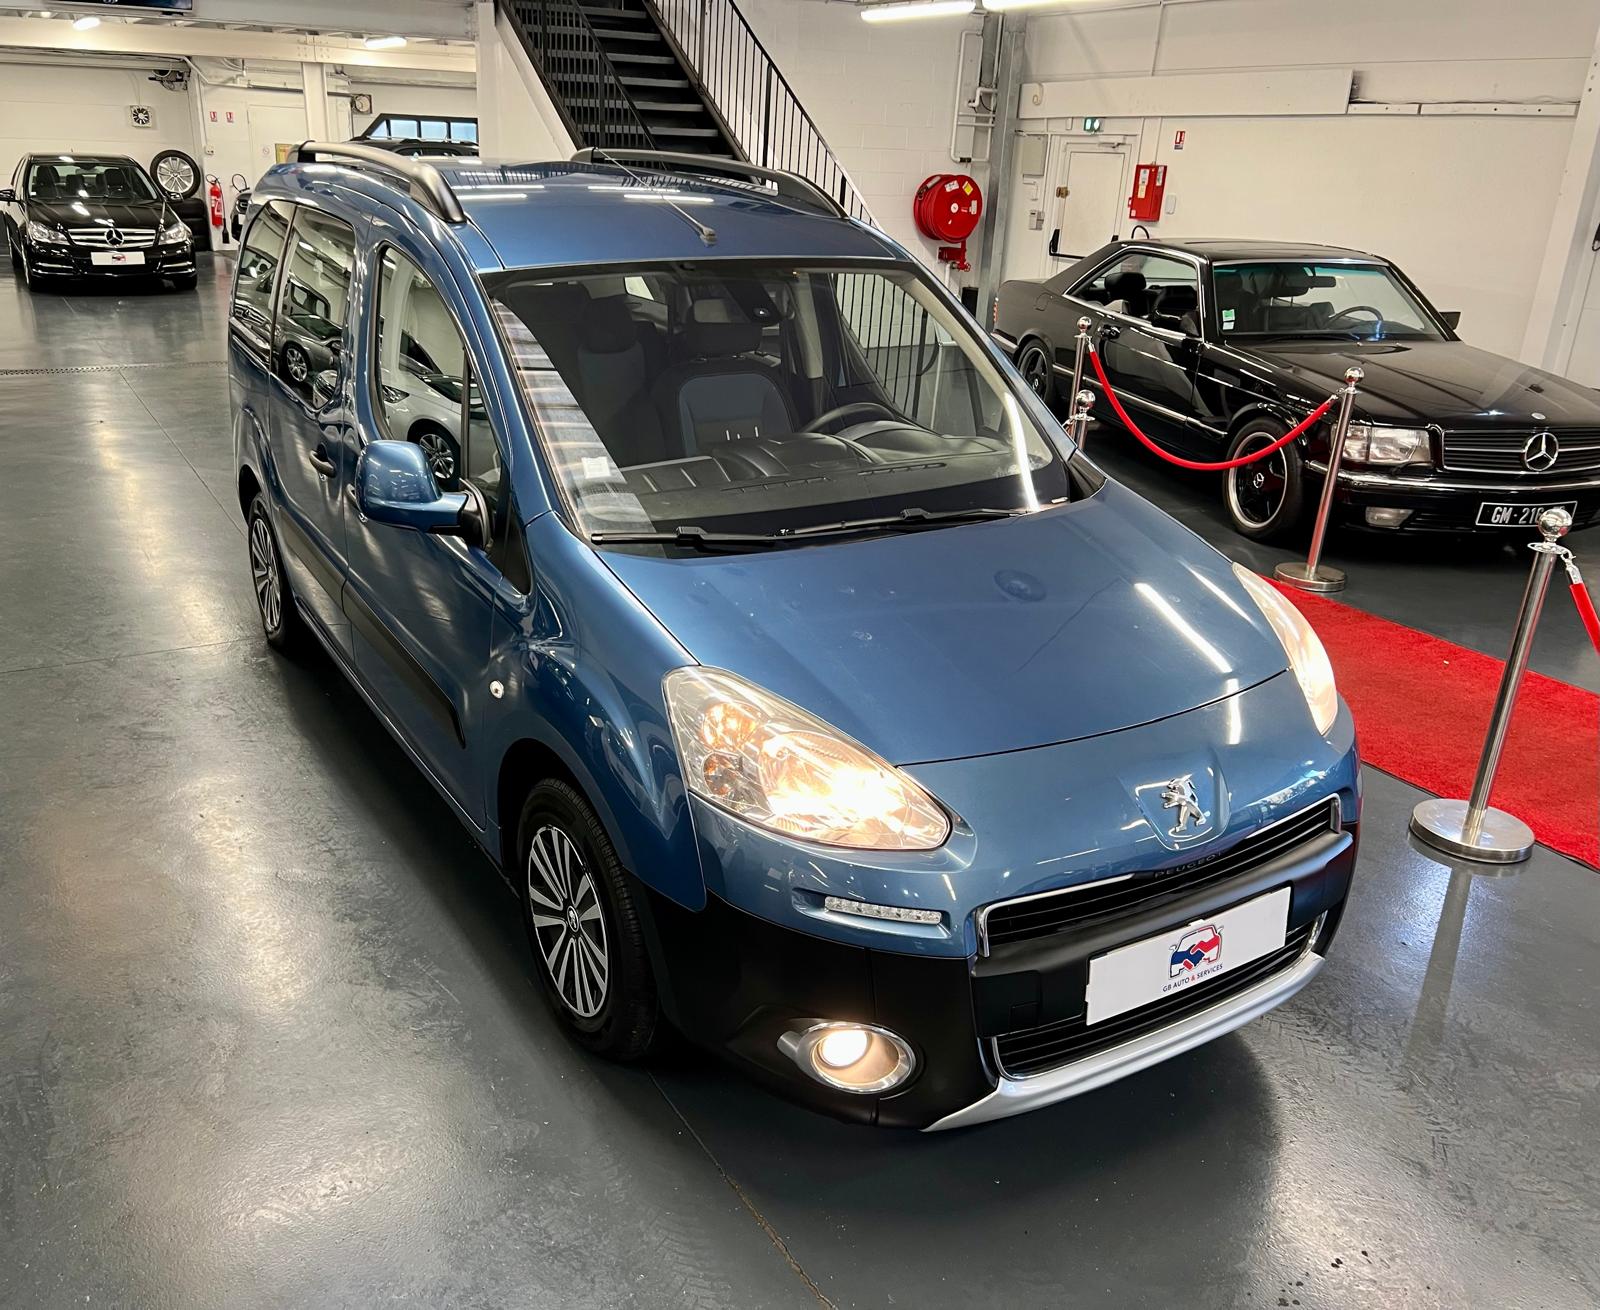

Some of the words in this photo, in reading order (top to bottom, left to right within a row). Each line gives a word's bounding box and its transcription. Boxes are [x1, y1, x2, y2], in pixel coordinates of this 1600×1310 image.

[1491, 506, 1513, 524] GM
[1162, 984, 1172, 992] GB
[1173, 977, 1190, 988] AUTO
[1190, 974, 1196, 982] &
[1196, 963, 1223, 979] SERVICES
